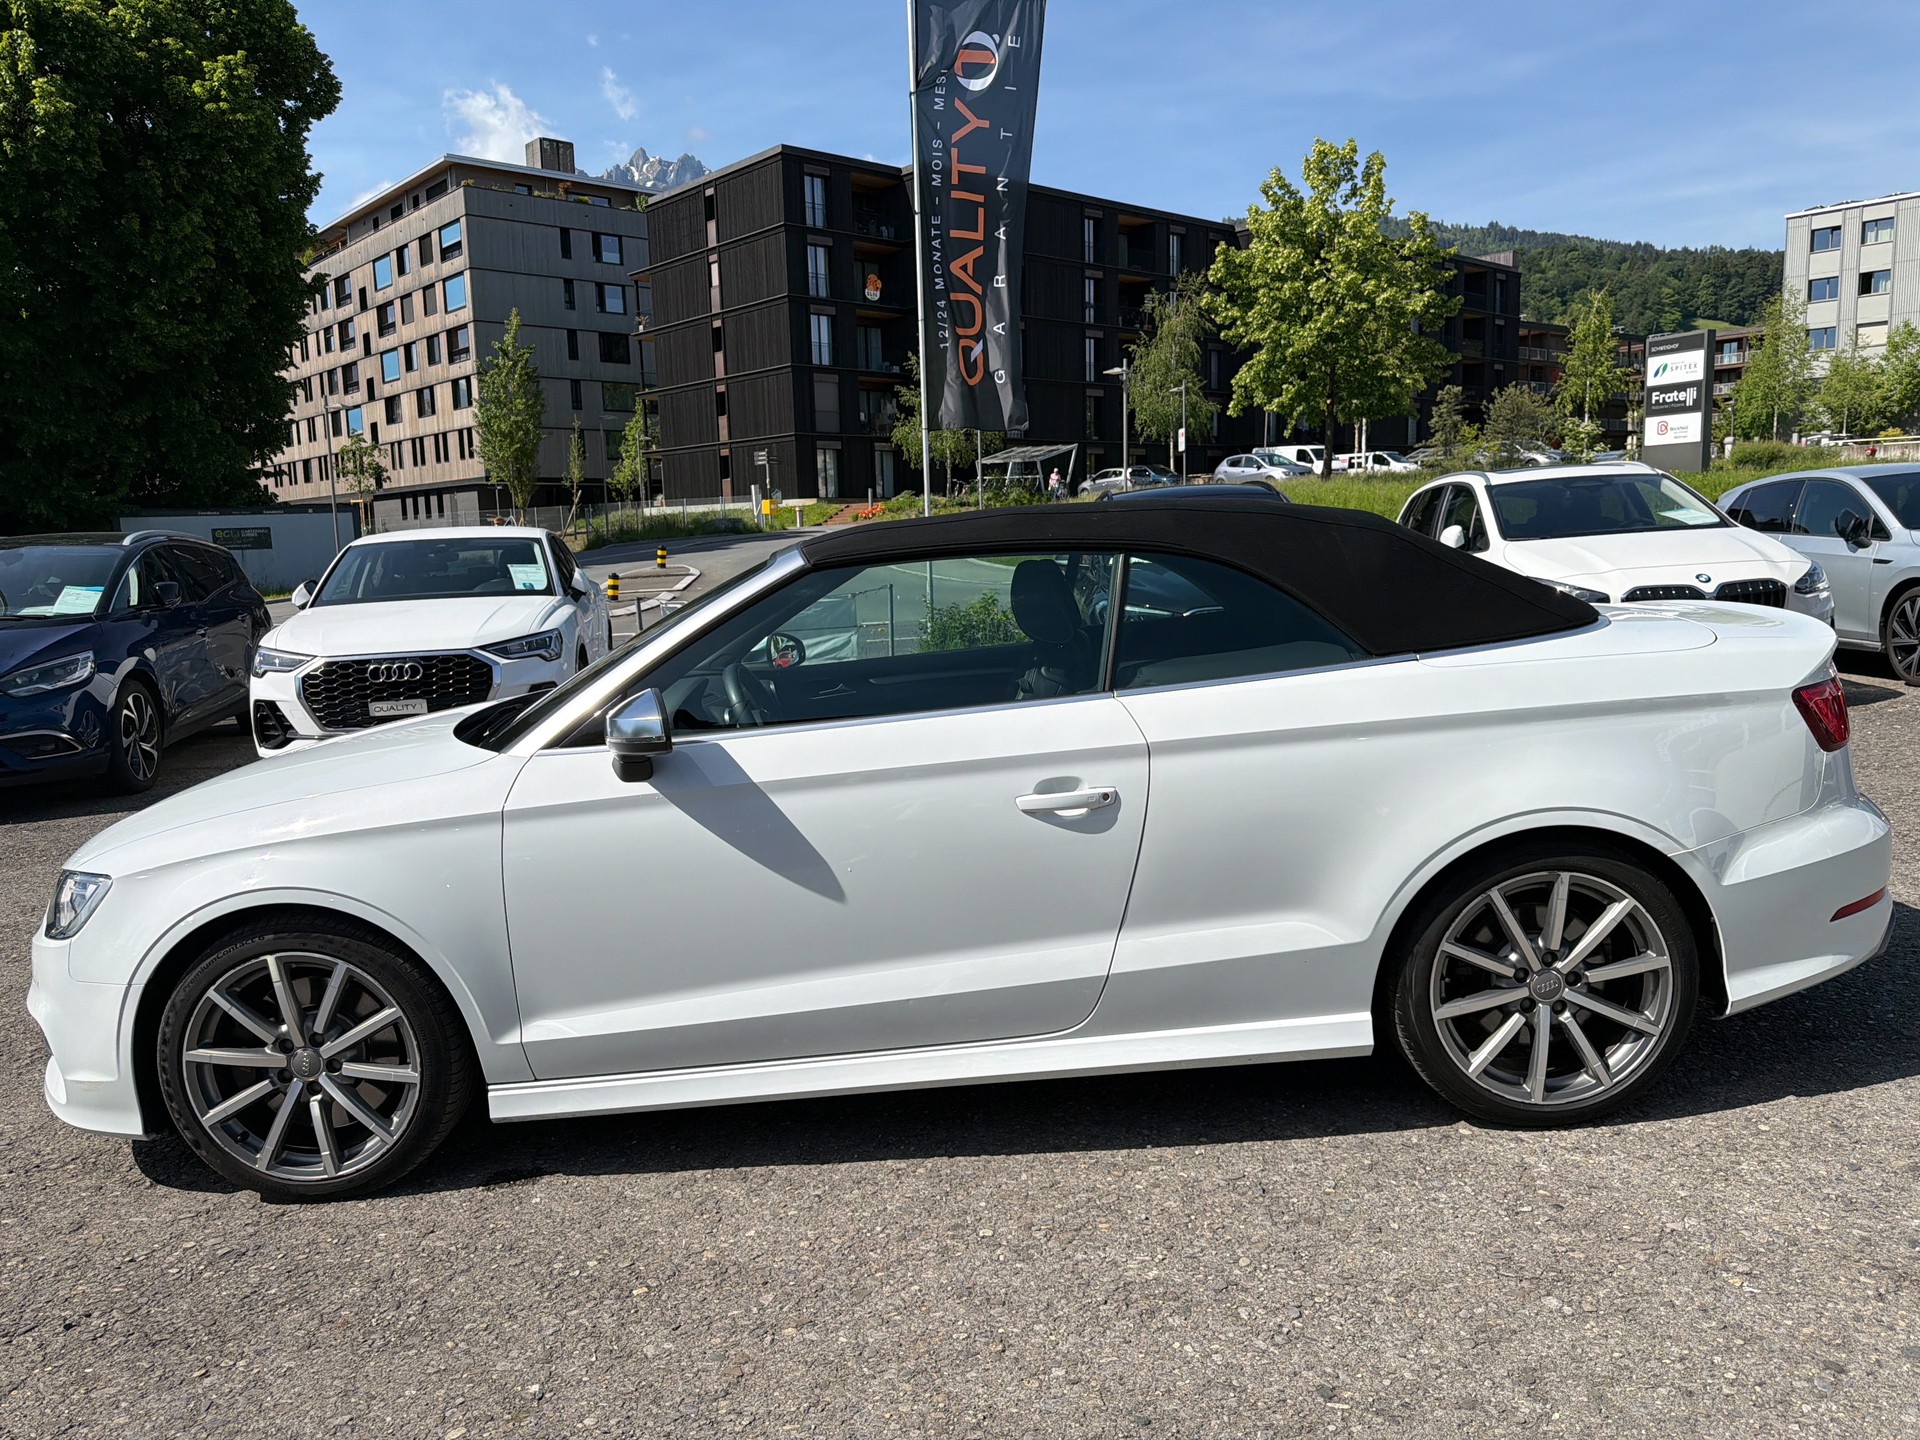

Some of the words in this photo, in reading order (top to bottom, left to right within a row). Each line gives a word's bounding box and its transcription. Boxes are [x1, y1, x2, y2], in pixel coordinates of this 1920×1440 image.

[931, 138, 943, 187] MOIS
[931, 215, 944, 290] MONATE
[949, 97, 990, 386] QUALITY
[937, 300, 949, 349] 12/24
[1670, 363, 1697, 372] SPITEX
[1651, 387, 1697, 406] Fratelli
[374, 704, 416, 713] QUALITY
[182, 938, 257, 993] PremiumContact
